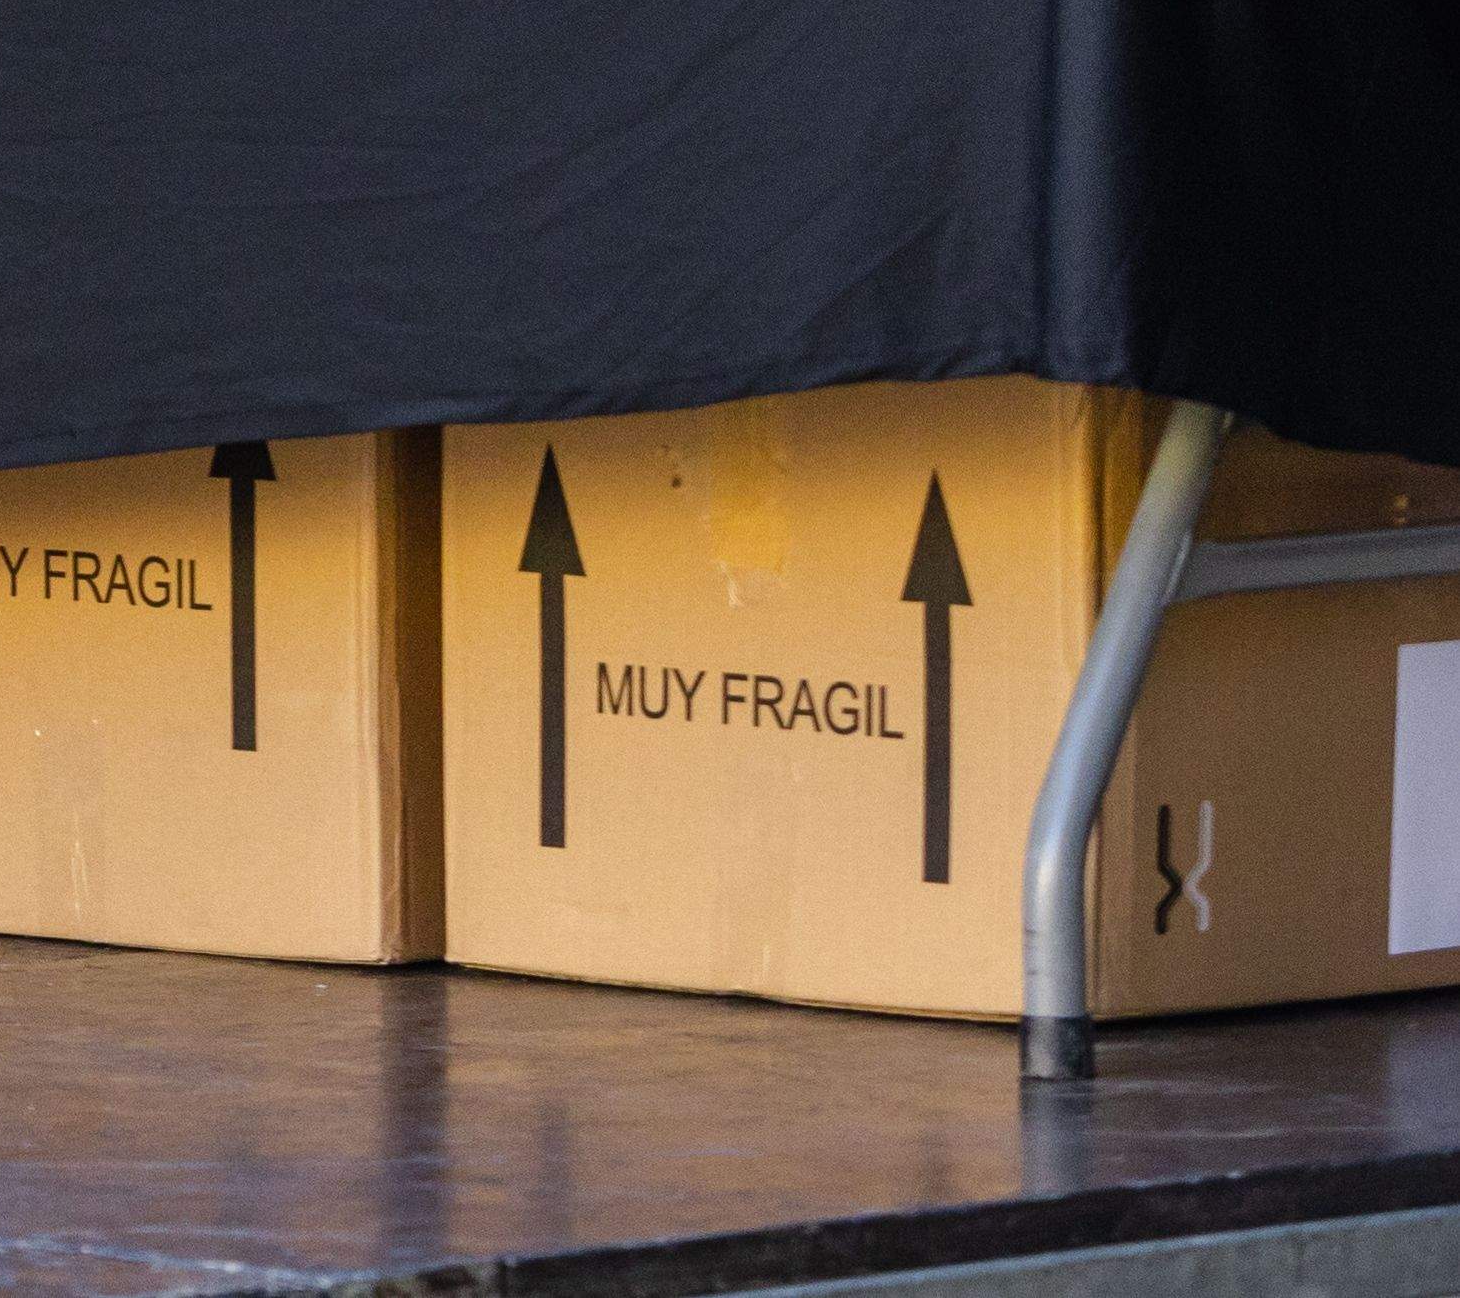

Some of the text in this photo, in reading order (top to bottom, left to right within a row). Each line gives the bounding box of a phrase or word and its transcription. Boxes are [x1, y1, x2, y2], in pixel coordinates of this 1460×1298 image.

[43, 548, 213, 612] FRAGIL
[597, 663, 905, 741] MUY FRAGIL
